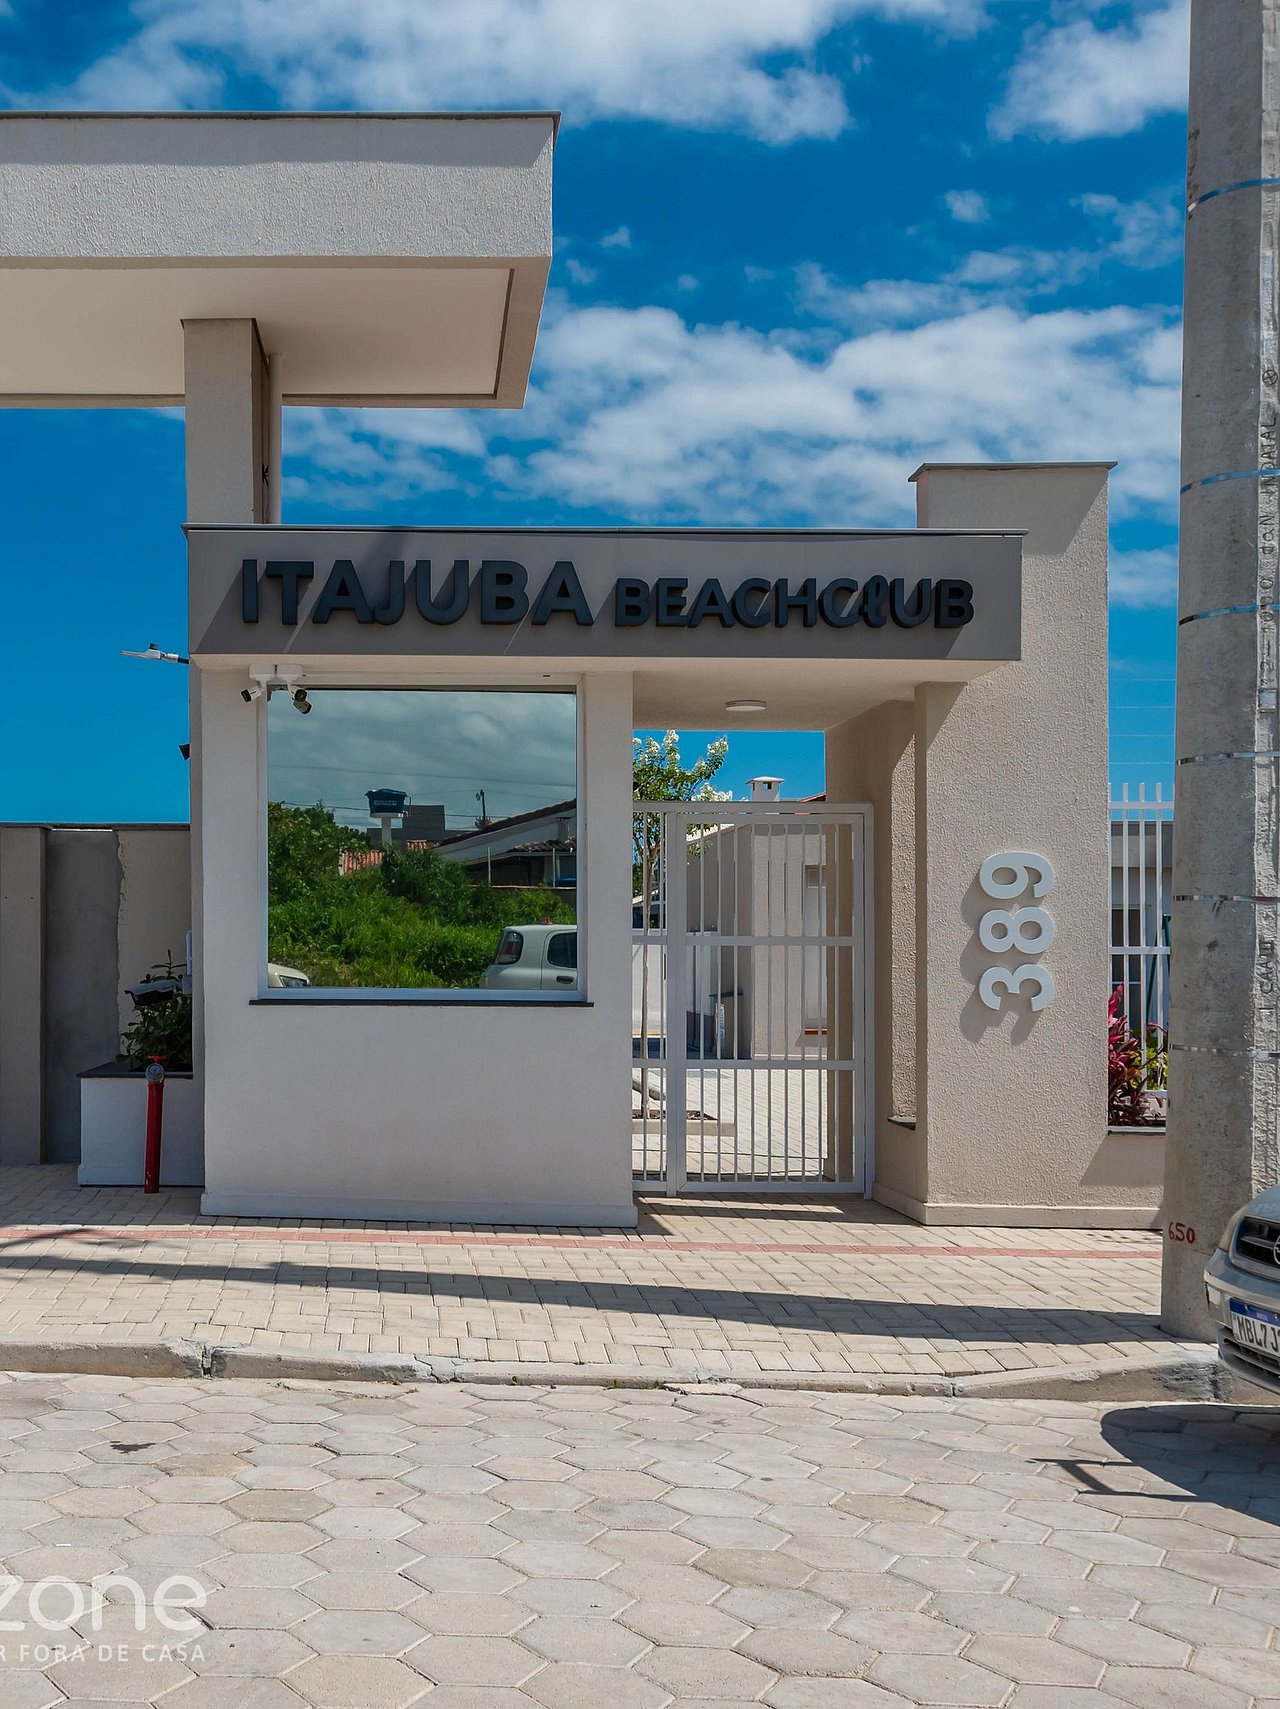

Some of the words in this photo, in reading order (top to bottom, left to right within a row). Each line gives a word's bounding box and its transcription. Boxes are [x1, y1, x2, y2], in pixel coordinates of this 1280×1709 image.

[242, 559, 594, 625] ITAJUBA
[979, 852, 1055, 1012] 389
[1168, 1221, 1195, 1244] 650
